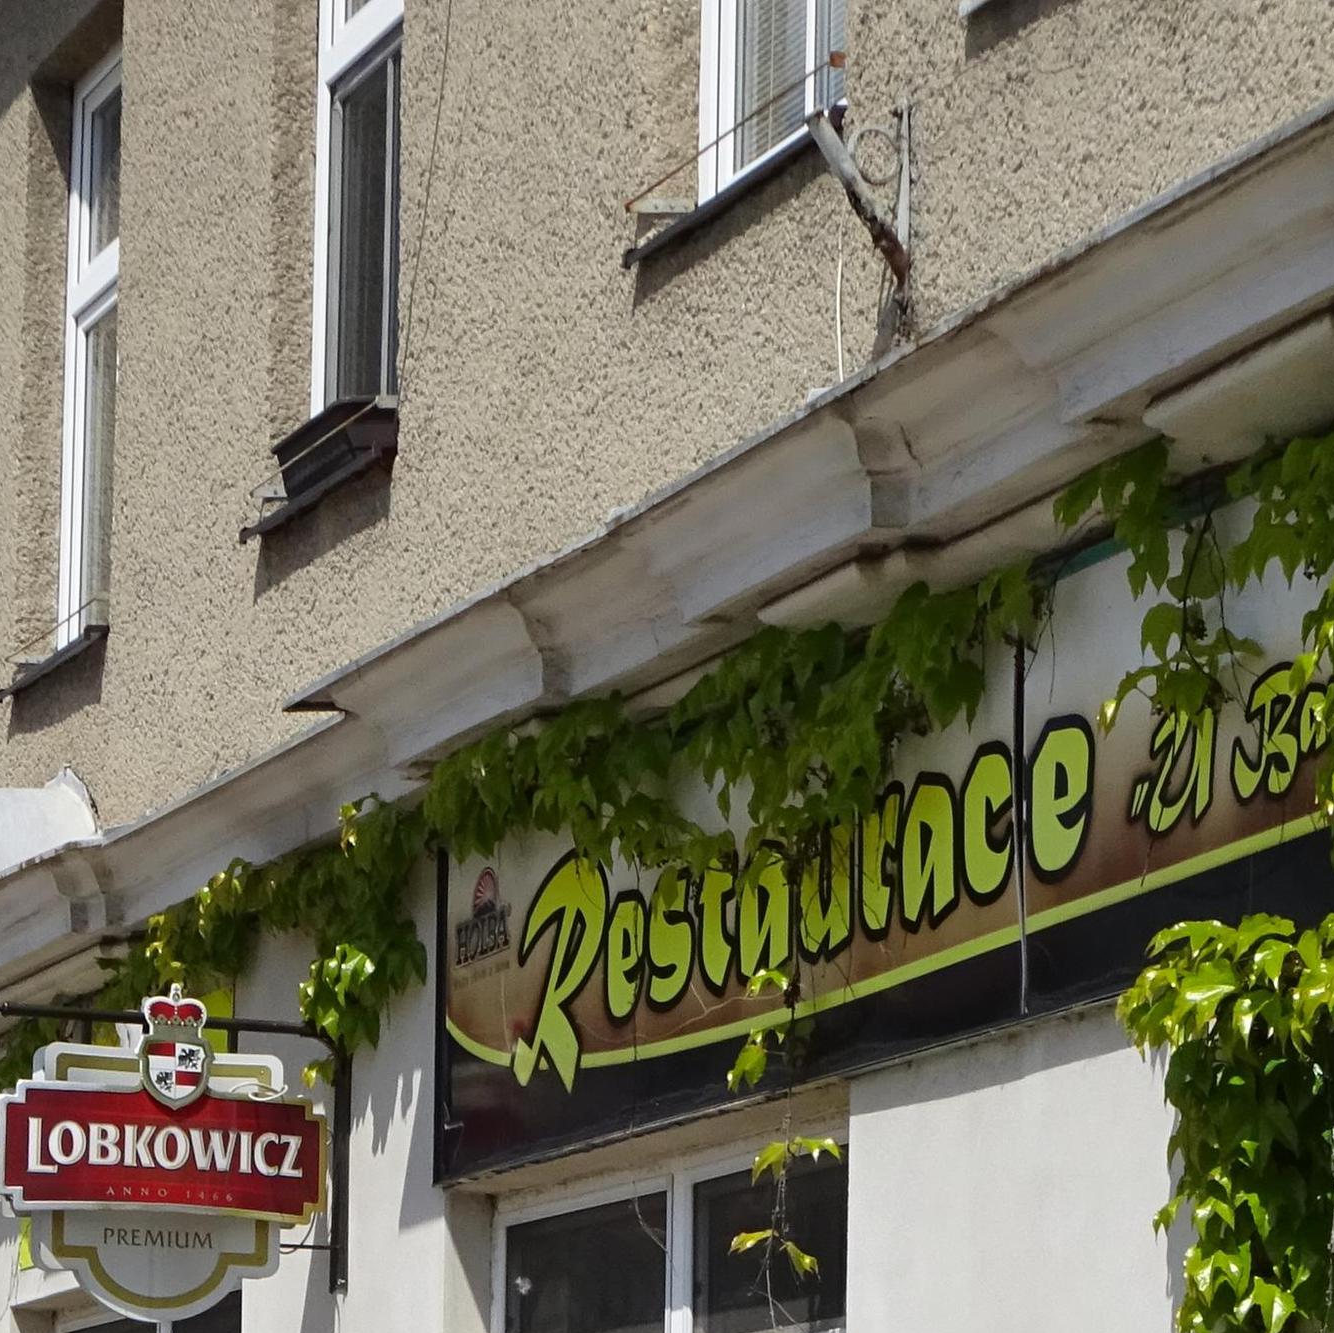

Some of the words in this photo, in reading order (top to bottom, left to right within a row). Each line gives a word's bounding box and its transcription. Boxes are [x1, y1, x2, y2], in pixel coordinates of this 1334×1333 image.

[517, 713, 1095, 1094] Restaurace
[26, 1116, 304, 1179] LOBKOWICZ
[106, 1186, 168, 1198] ANNO
[186, 1190, 234, 1203] 1466
[103, 1227, 213, 1249] PREMIUM
